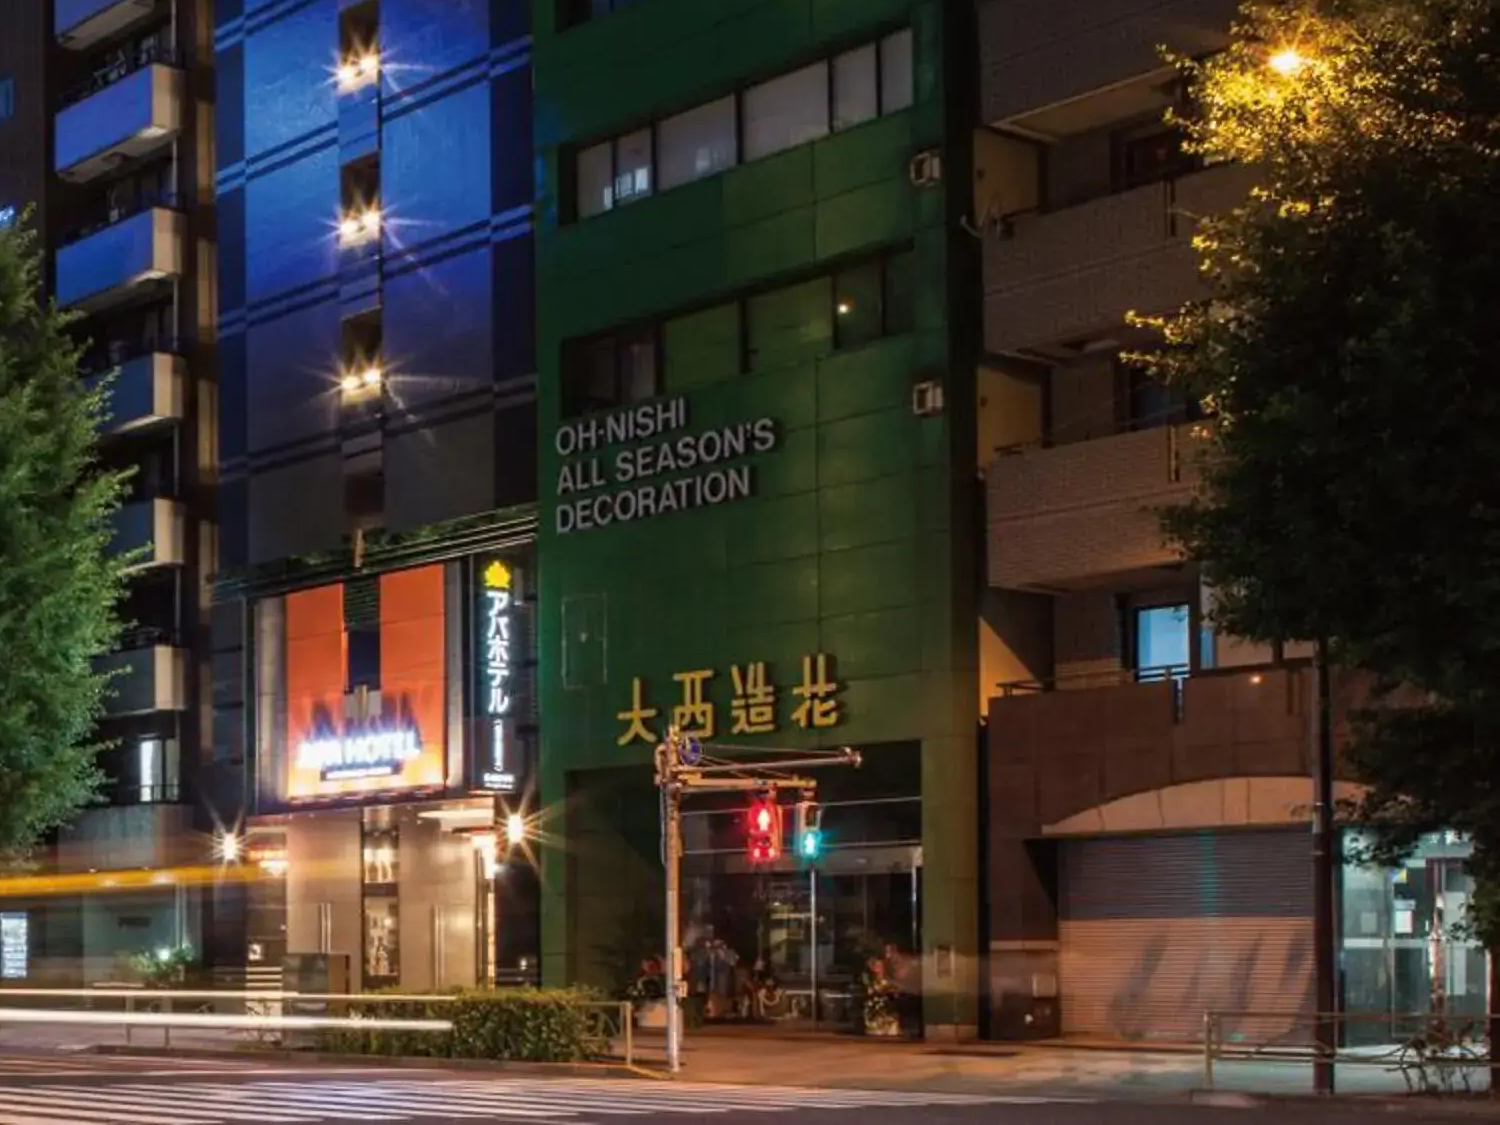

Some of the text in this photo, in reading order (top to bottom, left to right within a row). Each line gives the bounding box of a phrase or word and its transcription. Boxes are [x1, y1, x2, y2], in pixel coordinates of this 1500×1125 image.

[556, 418, 776, 496] ALL SEASON'S
[555, 465, 750, 535] DECORATION
[486, 590, 510, 714] アパホテル
[616, 653, 839, 746] 大西造花
